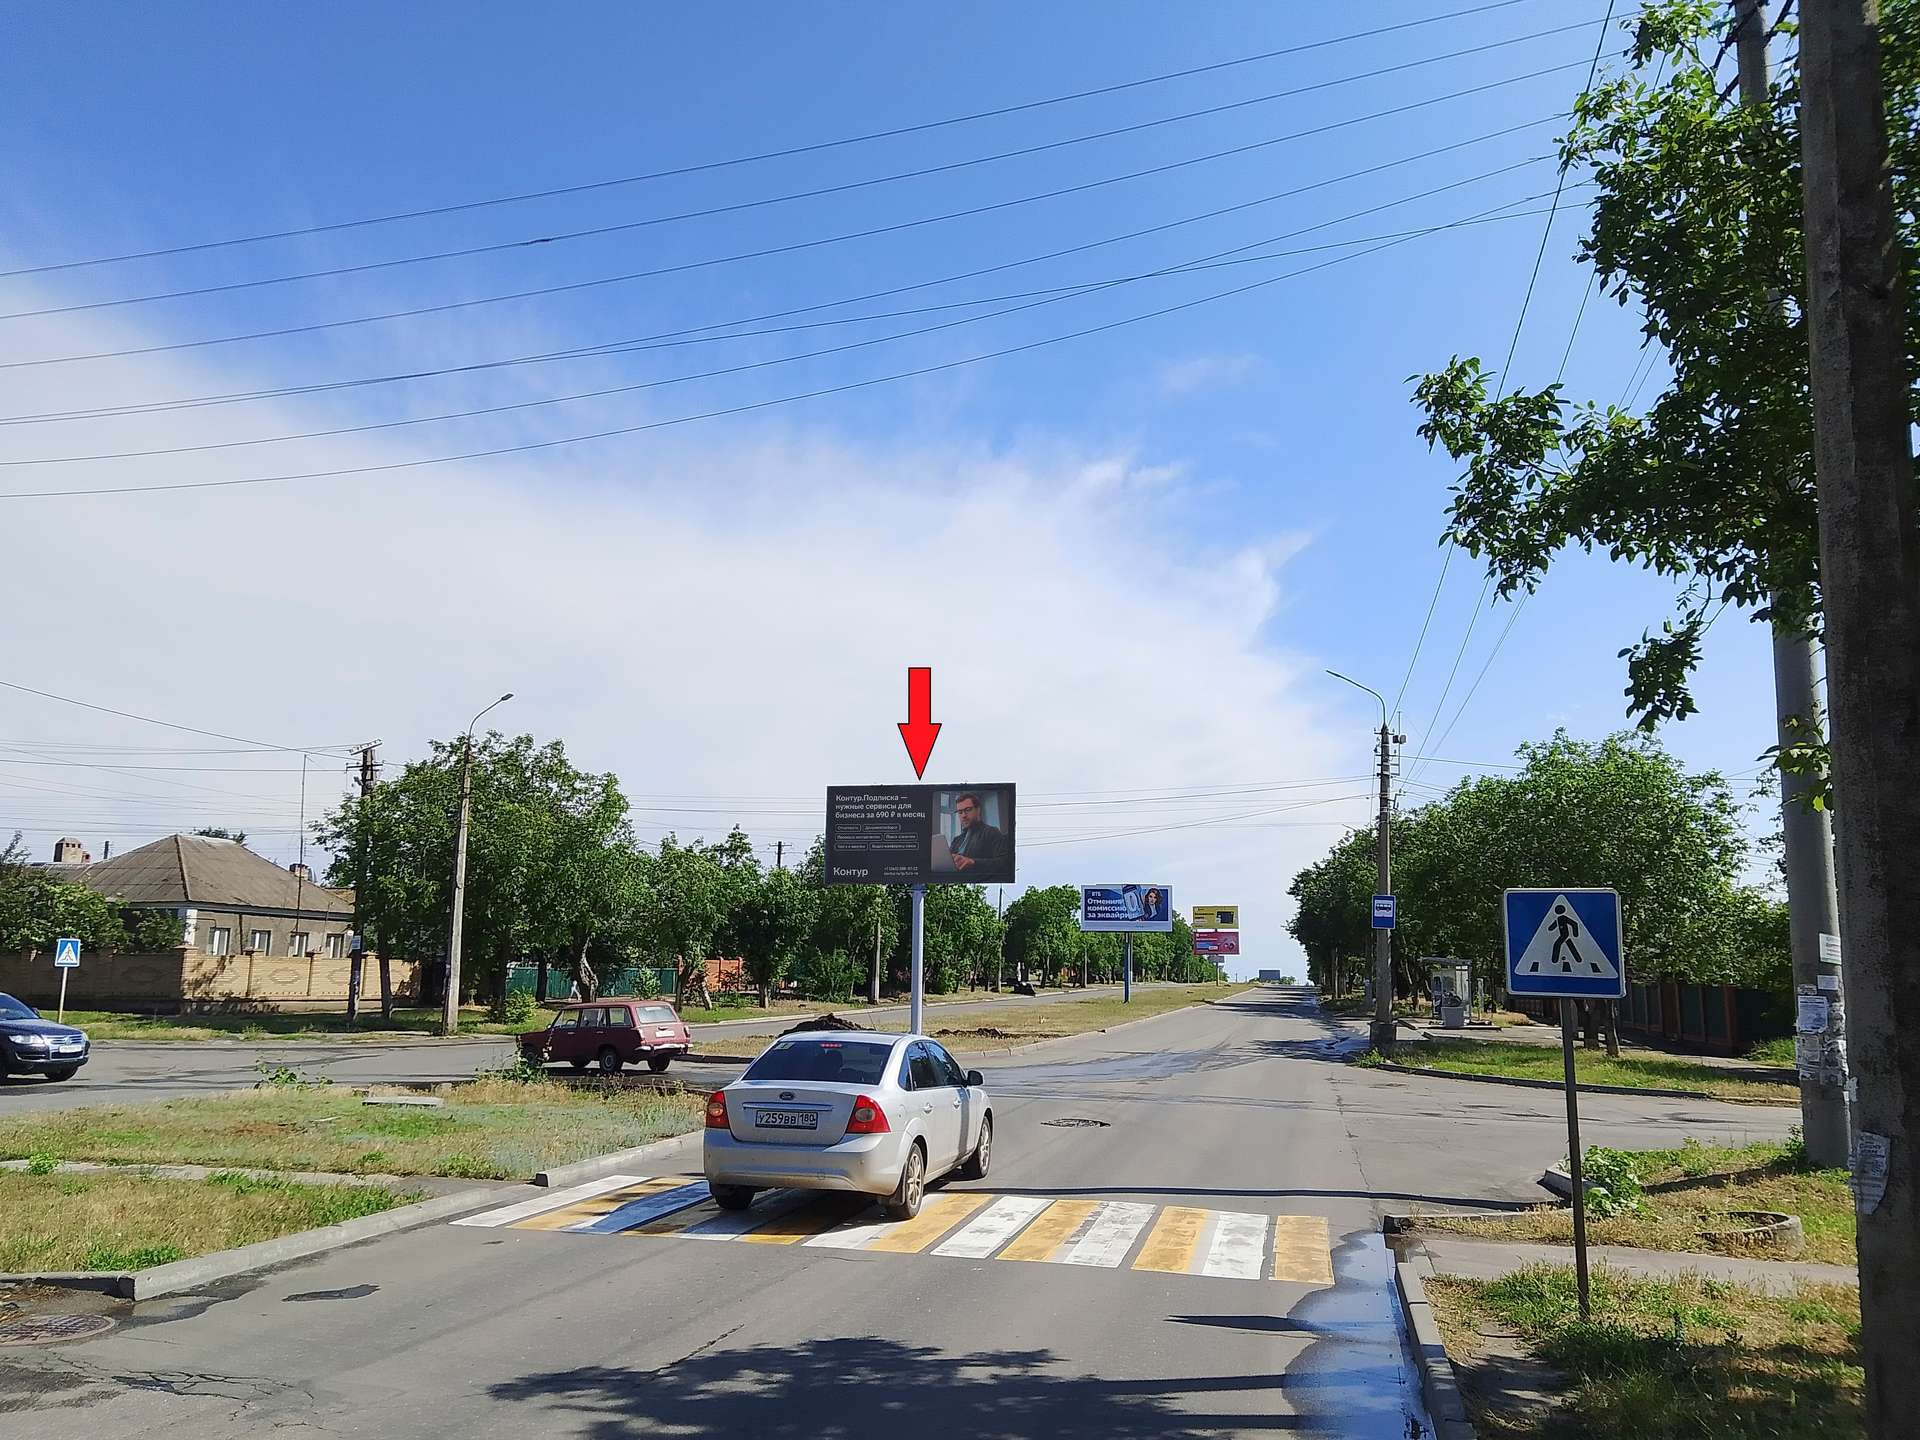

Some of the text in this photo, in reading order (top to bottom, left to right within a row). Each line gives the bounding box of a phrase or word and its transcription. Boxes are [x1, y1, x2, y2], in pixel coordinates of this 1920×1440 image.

[835, 794, 899, 802] Контур.Подписка
[835, 811, 865, 819] бизнеса
[902, 811, 926, 819] месяц
[833, 866, 869, 877] Контур
